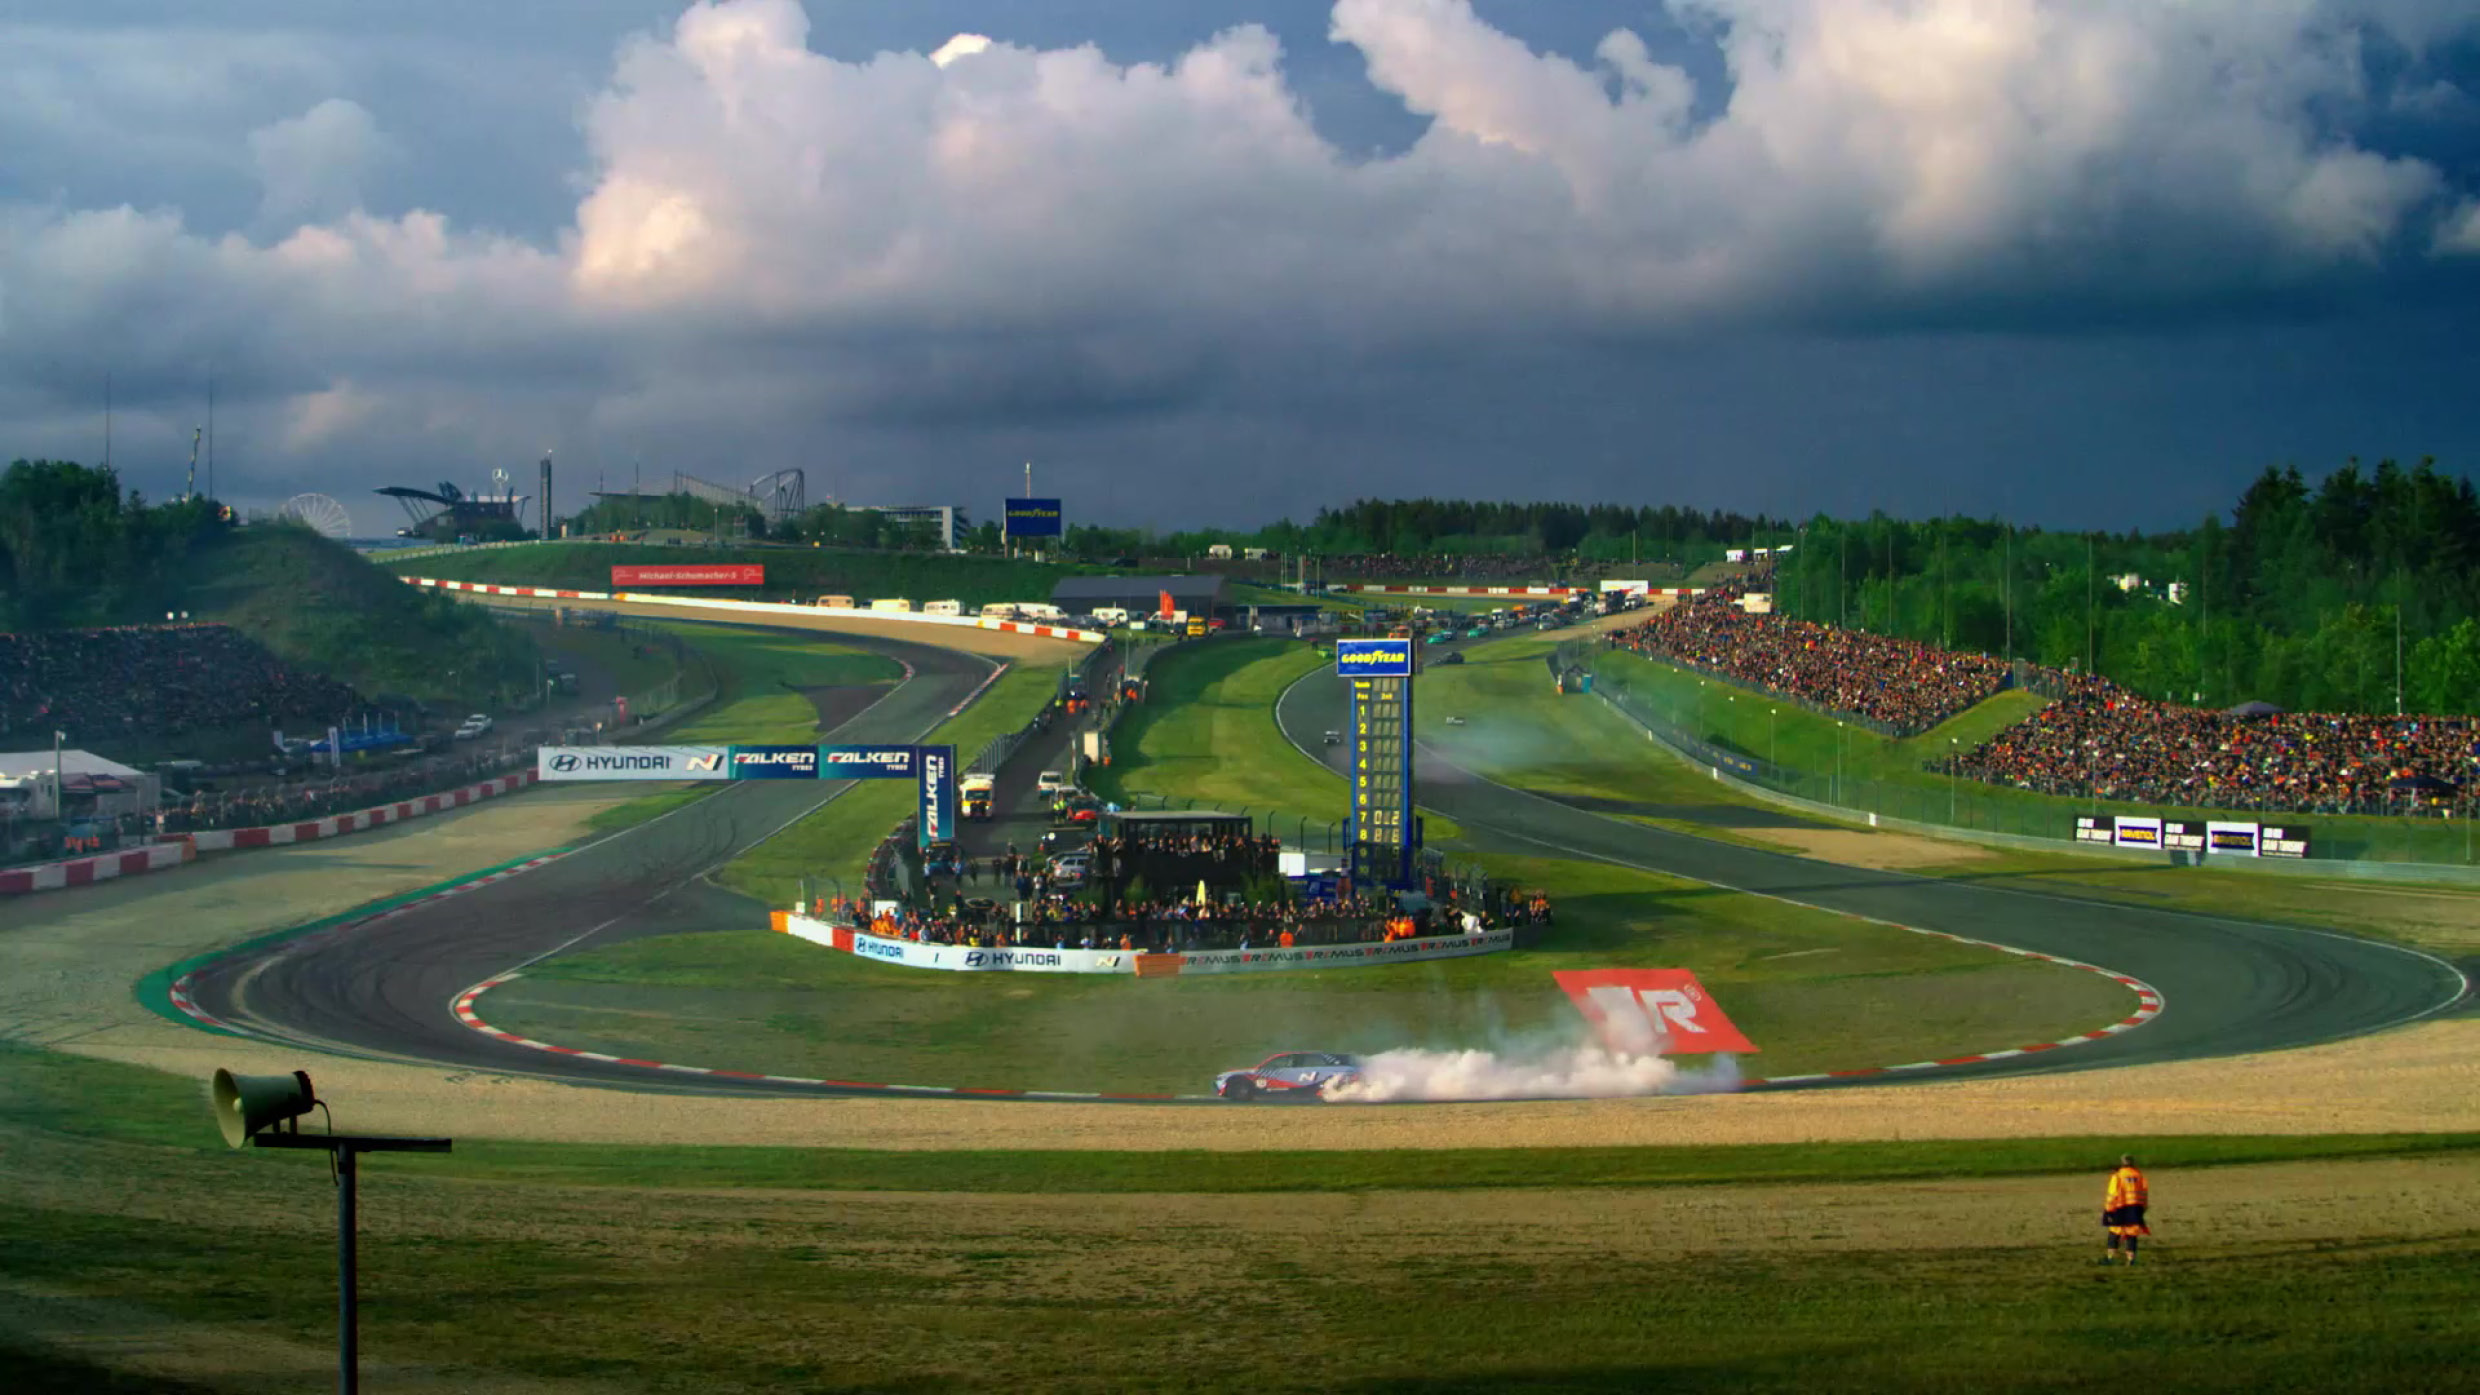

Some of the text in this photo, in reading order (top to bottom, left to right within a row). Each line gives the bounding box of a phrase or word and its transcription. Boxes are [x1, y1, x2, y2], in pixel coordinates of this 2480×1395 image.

[1341, 650, 1406, 666] GOODYEAR
[1359, 723, 1367, 735] 2
[1359, 741, 1367, 752] 3
[586, 756, 670, 769] HYUNDAI
[734, 752, 815, 764] FALKEN
[828, 752, 910, 763] FALKEN
[1359, 758, 1368, 770] 4
[1359, 776, 1367, 788] 5
[926, 754, 938, 837] FALKEN
[1359, 794, 1367, 806] 6
[1359, 811, 1367, 822] 7
[1359, 829, 1368, 840] 8
[867, 942, 904, 958] HYUNDAI
[1186, 955, 1240, 965] REMUS
[1250, 951, 1305, 962] REMUS
[1312, 948, 1364, 960] REMUS
[1374, 944, 1418, 955] REMUS
[992, 952, 1061, 966] HYUNDAI
